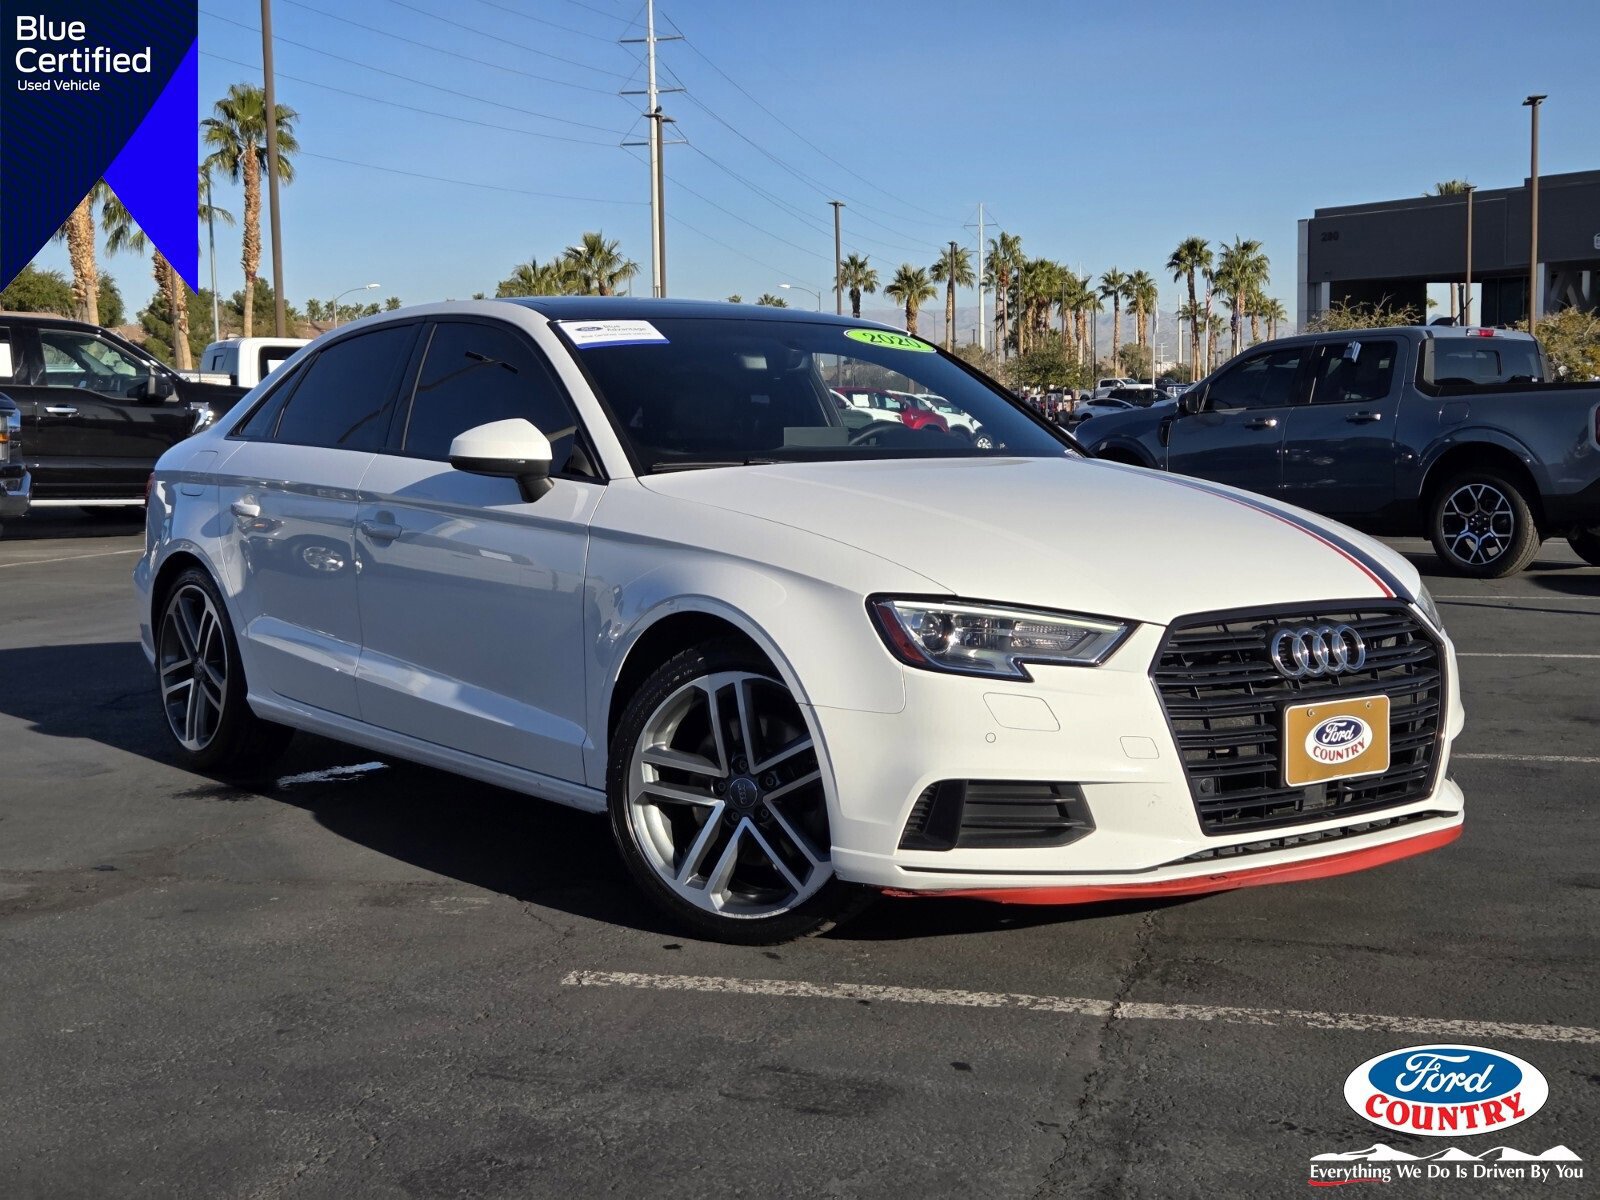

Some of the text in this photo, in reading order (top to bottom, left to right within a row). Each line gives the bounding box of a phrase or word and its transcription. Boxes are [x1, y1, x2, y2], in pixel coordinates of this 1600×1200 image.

[862, 332, 922, 349] 2020
[1322, 722, 1355, 744] Ford
[1313, 737, 1366, 762] COUNTRY
